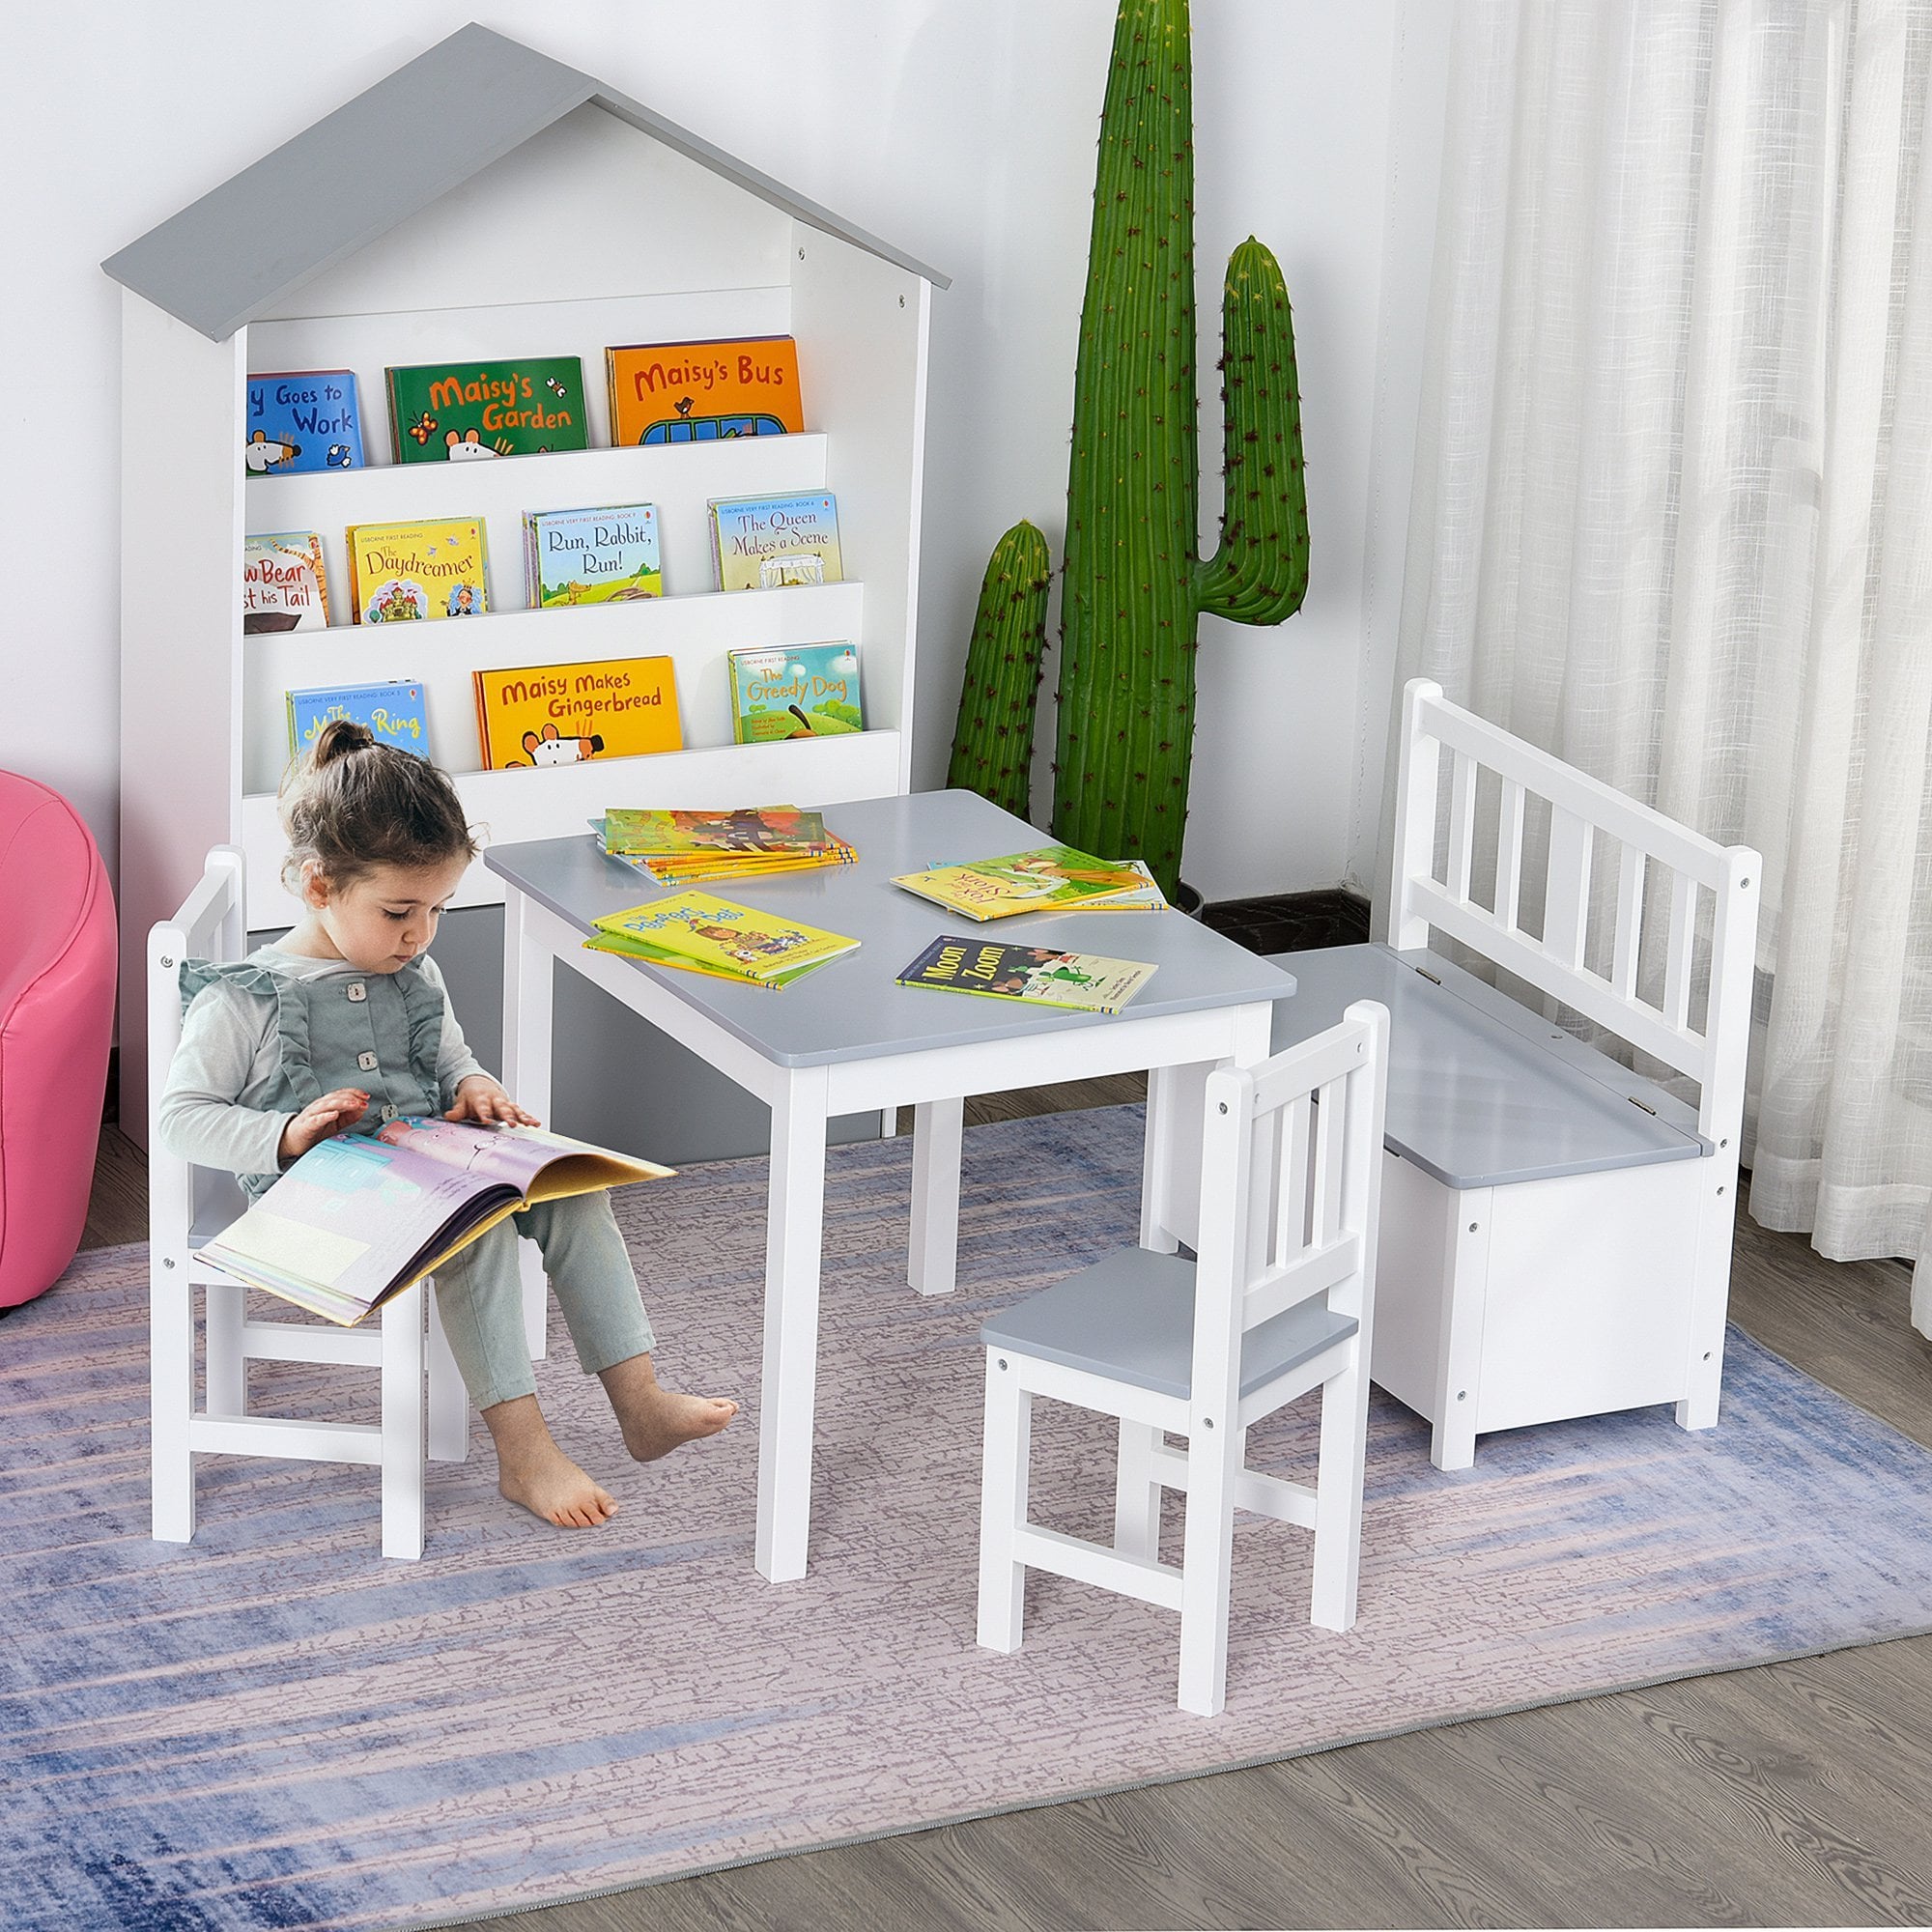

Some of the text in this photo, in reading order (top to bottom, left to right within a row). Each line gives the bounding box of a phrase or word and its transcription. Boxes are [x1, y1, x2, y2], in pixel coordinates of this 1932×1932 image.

[429, 373, 532, 411] Maisy's
[634, 355, 784, 402] Maisy's Bus
[276, 384, 318, 405] Goes
[324, 385, 342, 401] to
[292, 408, 354, 435] Work
[482, 404, 573, 431] Garden
[737, 511, 817, 535] The Queen
[380, 546, 397, 557] The
[548, 523, 652, 552] Run, Rabbit,
[731, 526, 829, 556] Makes a Scene
[258, 559, 306, 584] Bear
[365, 551, 474, 579] Daydreamer
[582, 551, 623, 575] Run!
[261, 589, 278, 605] his
[277, 584, 310, 607] Tail
[501, 672, 631, 706] Maisy Makes
[760, 668, 783, 683] The
[548, 686, 662, 718] Gingerbread
[747, 676, 847, 705] Greedy Dog
[327, 704, 351, 721] The
[371, 708, 421, 739] Ring
[921, 945, 968, 980] Moon
[961, 945, 1007, 981] Zoom
